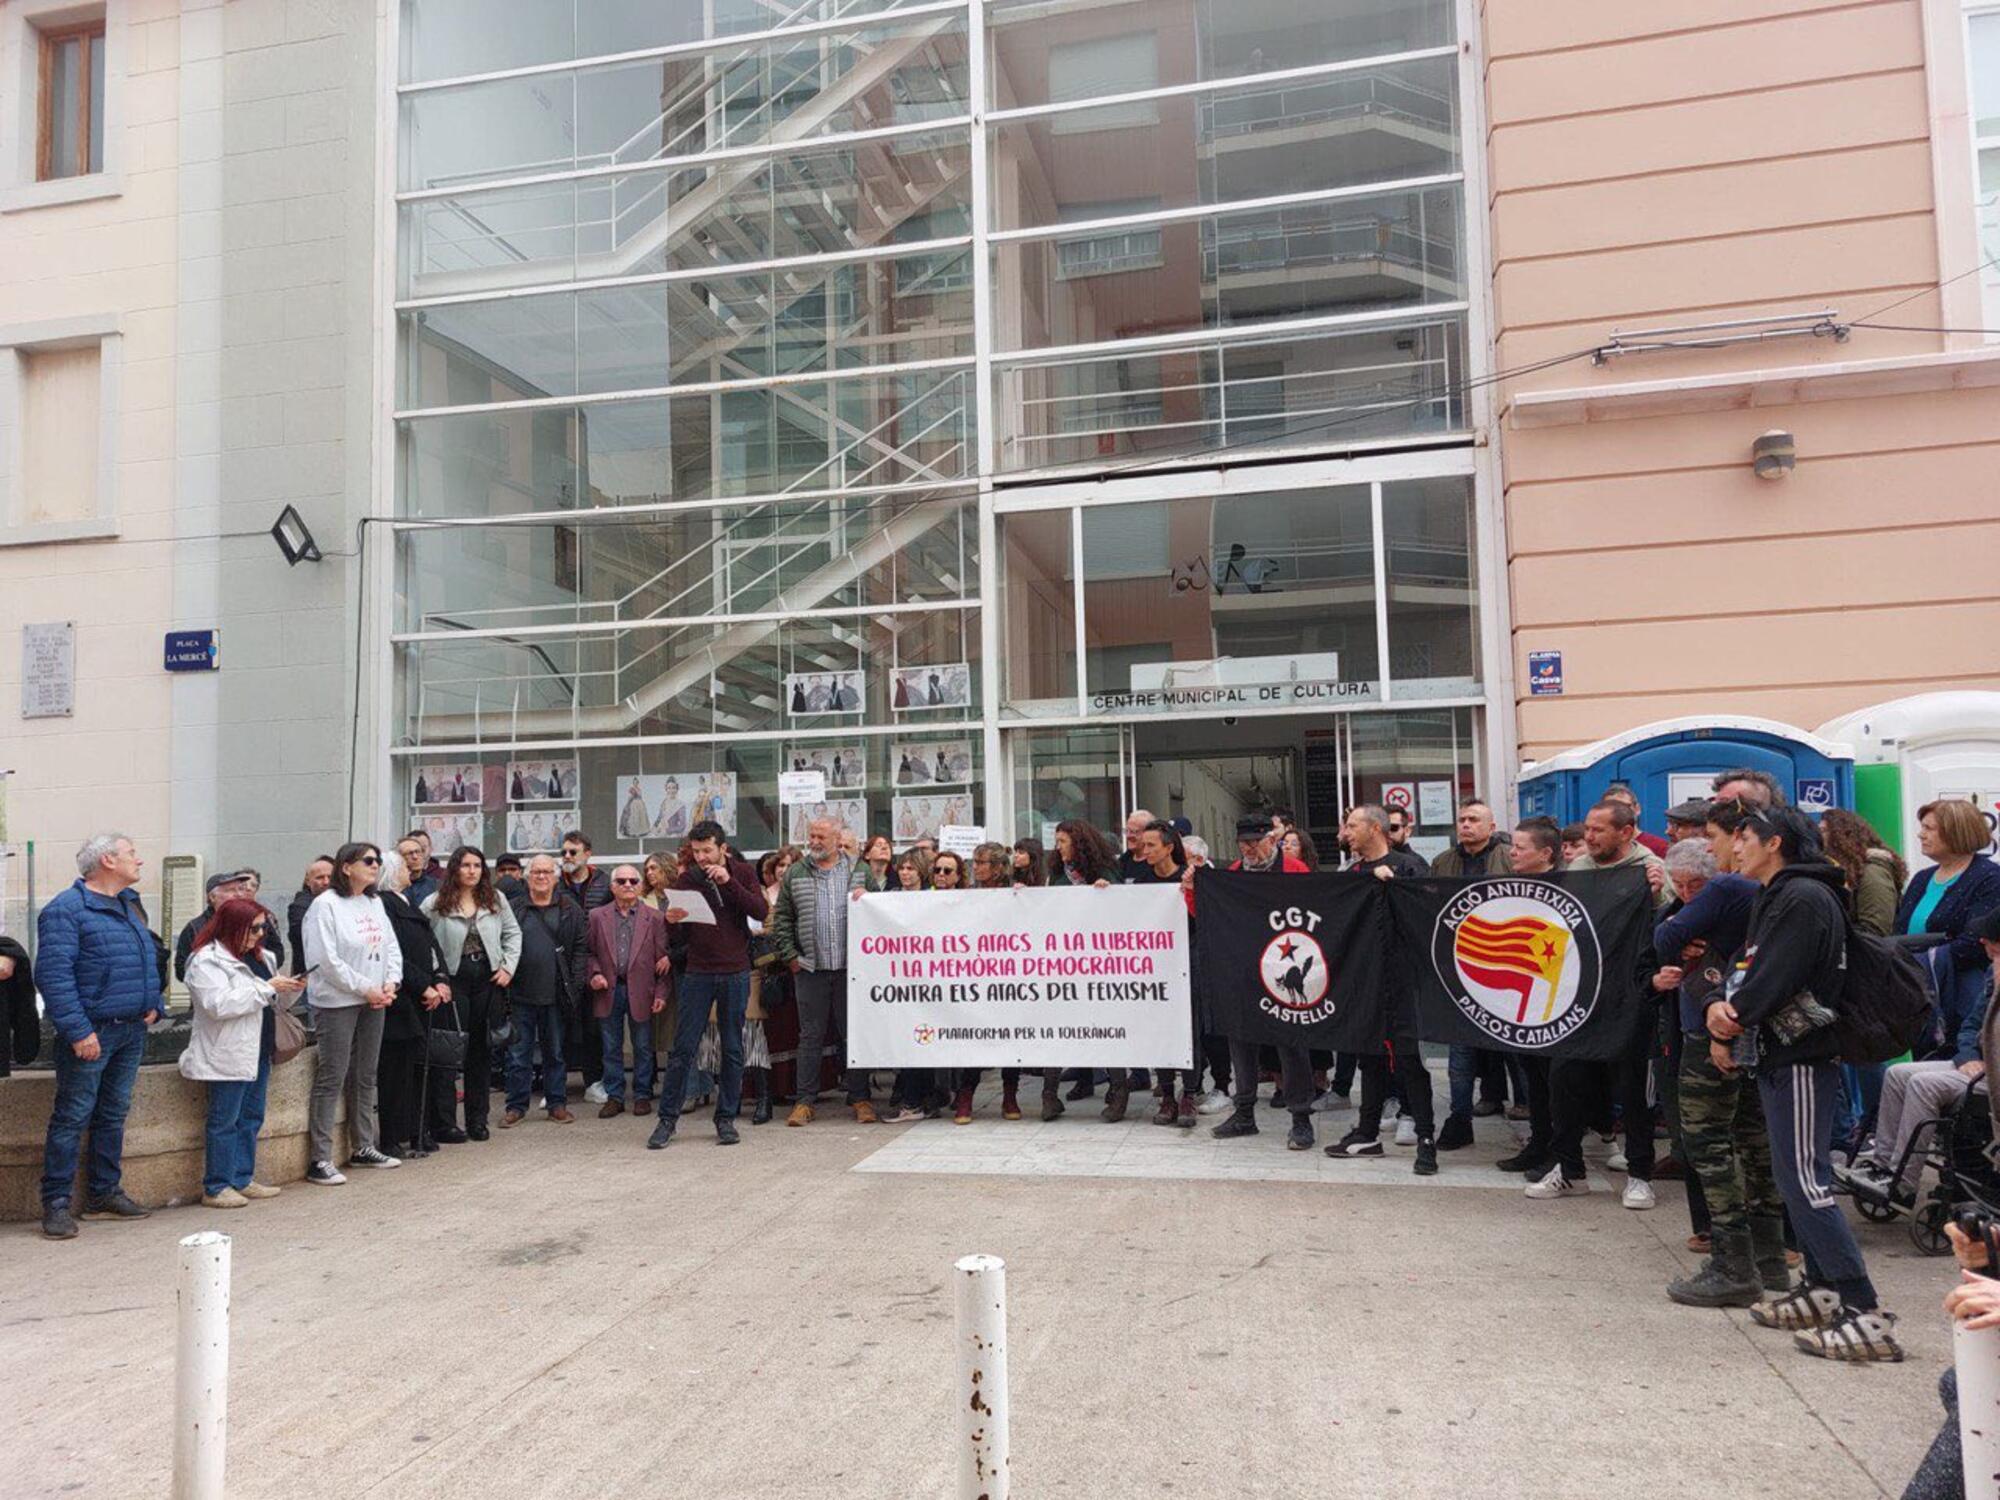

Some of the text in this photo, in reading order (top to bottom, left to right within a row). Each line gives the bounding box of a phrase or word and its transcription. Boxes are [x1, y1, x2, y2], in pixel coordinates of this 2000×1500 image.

[167, 654, 177, 662] LA
[1094, 682, 1370, 709] CENTRE MUNICIPAL DE CULTURA
[1268, 906, 1322, 932] CGT
[1442, 882, 1584, 931] ACCIÓ ANTIFEIXISTA
[861, 930, 1175, 955] CONTRA ELS ATACS A LA LLIBERTAT
[891, 952, 1153, 978] I LA MEMÒRIA DEMOCRÀTICA
[870, 981, 1169, 1003] CONTRA ELS ATACS DEL FEIXISME
[1259, 997, 1335, 1025] CASTELLÓ
[1458, 995, 1587, 1044] PAÏSOS CATALANS
[938, 1023, 1126, 1040] PLATAFORMA PER LA TOLERÀNCIA
